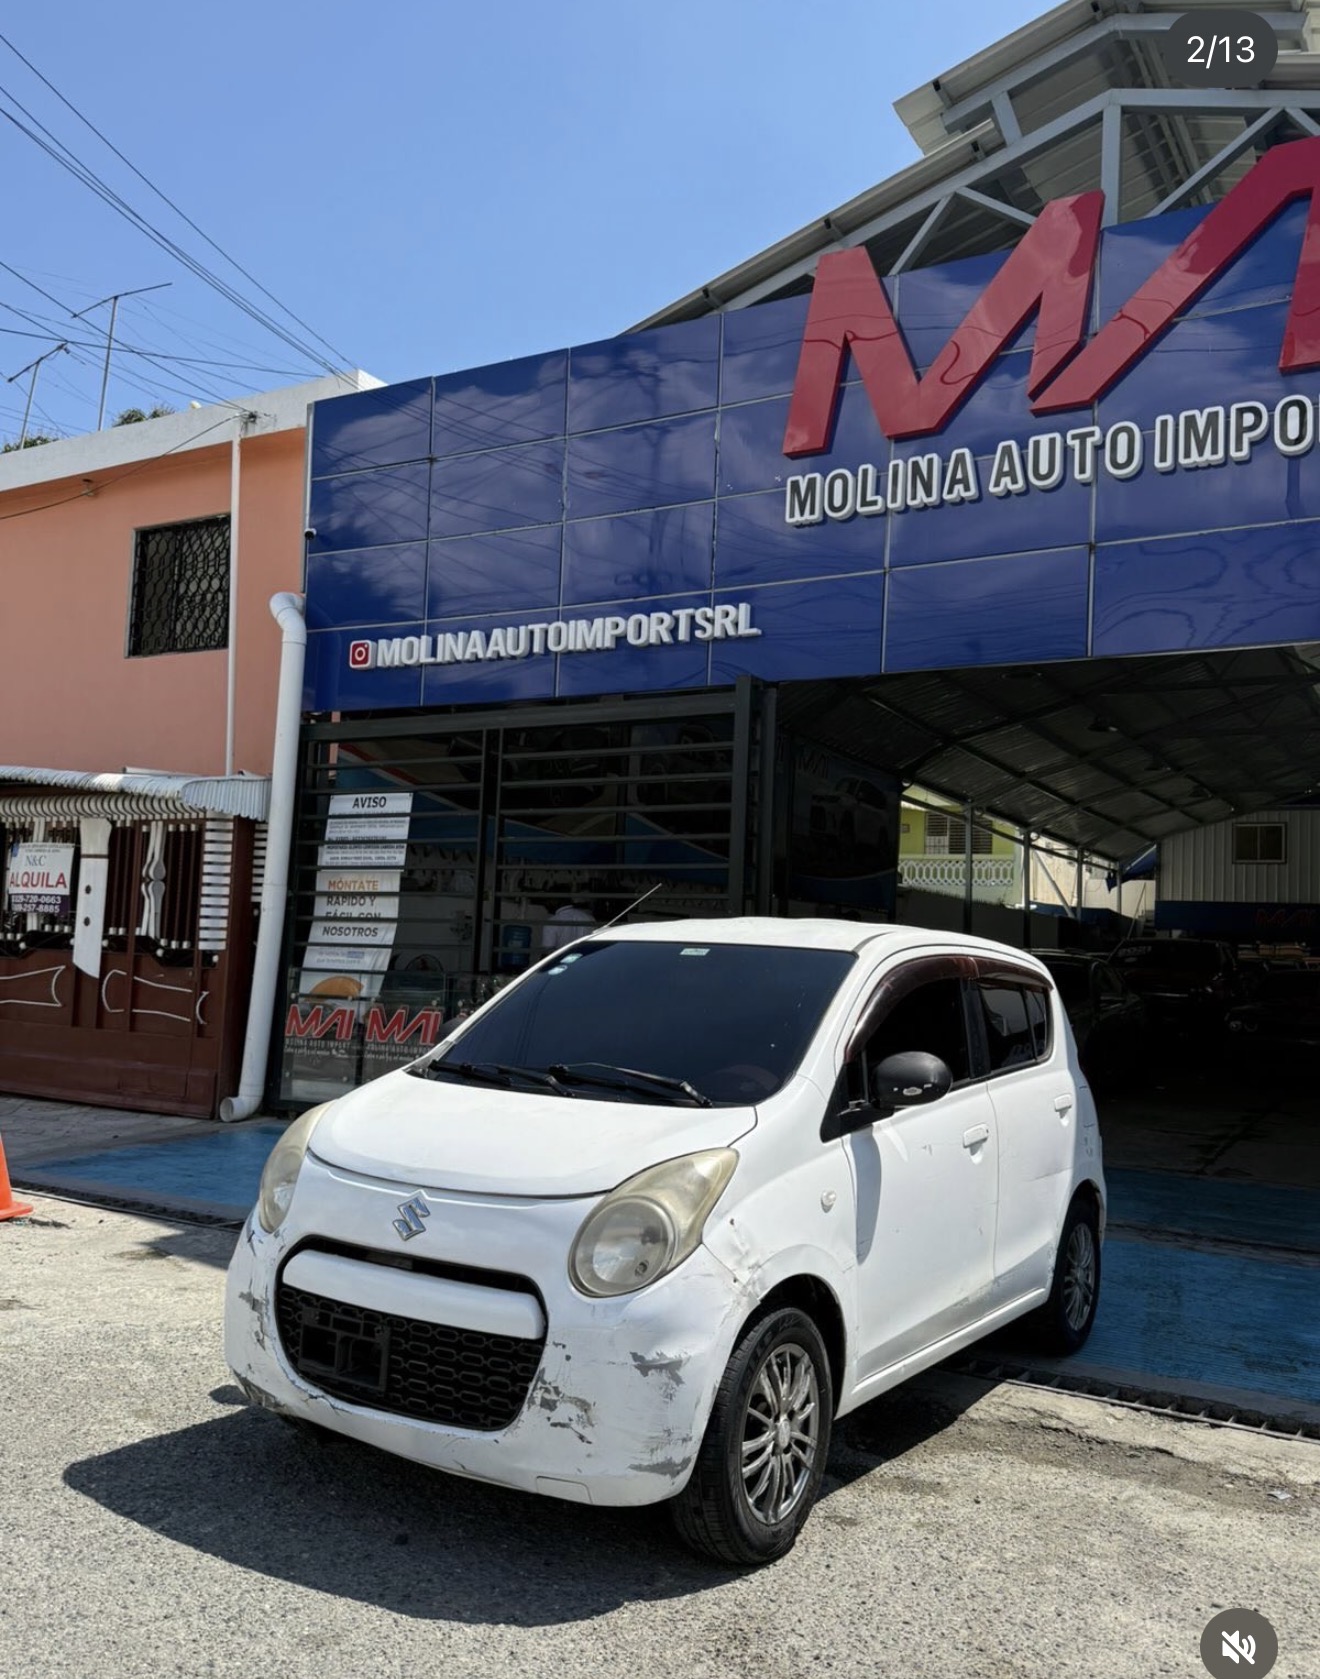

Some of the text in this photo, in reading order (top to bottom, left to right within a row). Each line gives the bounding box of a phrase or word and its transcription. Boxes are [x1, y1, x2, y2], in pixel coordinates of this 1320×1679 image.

[785, 394, 1320, 527] MOLINA AUTO IMPO
[376, 603, 762, 668] MOLINAAUTOIMPORTSRL
[352, 796, 387, 809] AVISO
[10, 872, 67, 888] ALQUILA
[370, 895, 377, 907] Y
[322, 926, 379, 937] NOSOTROS
